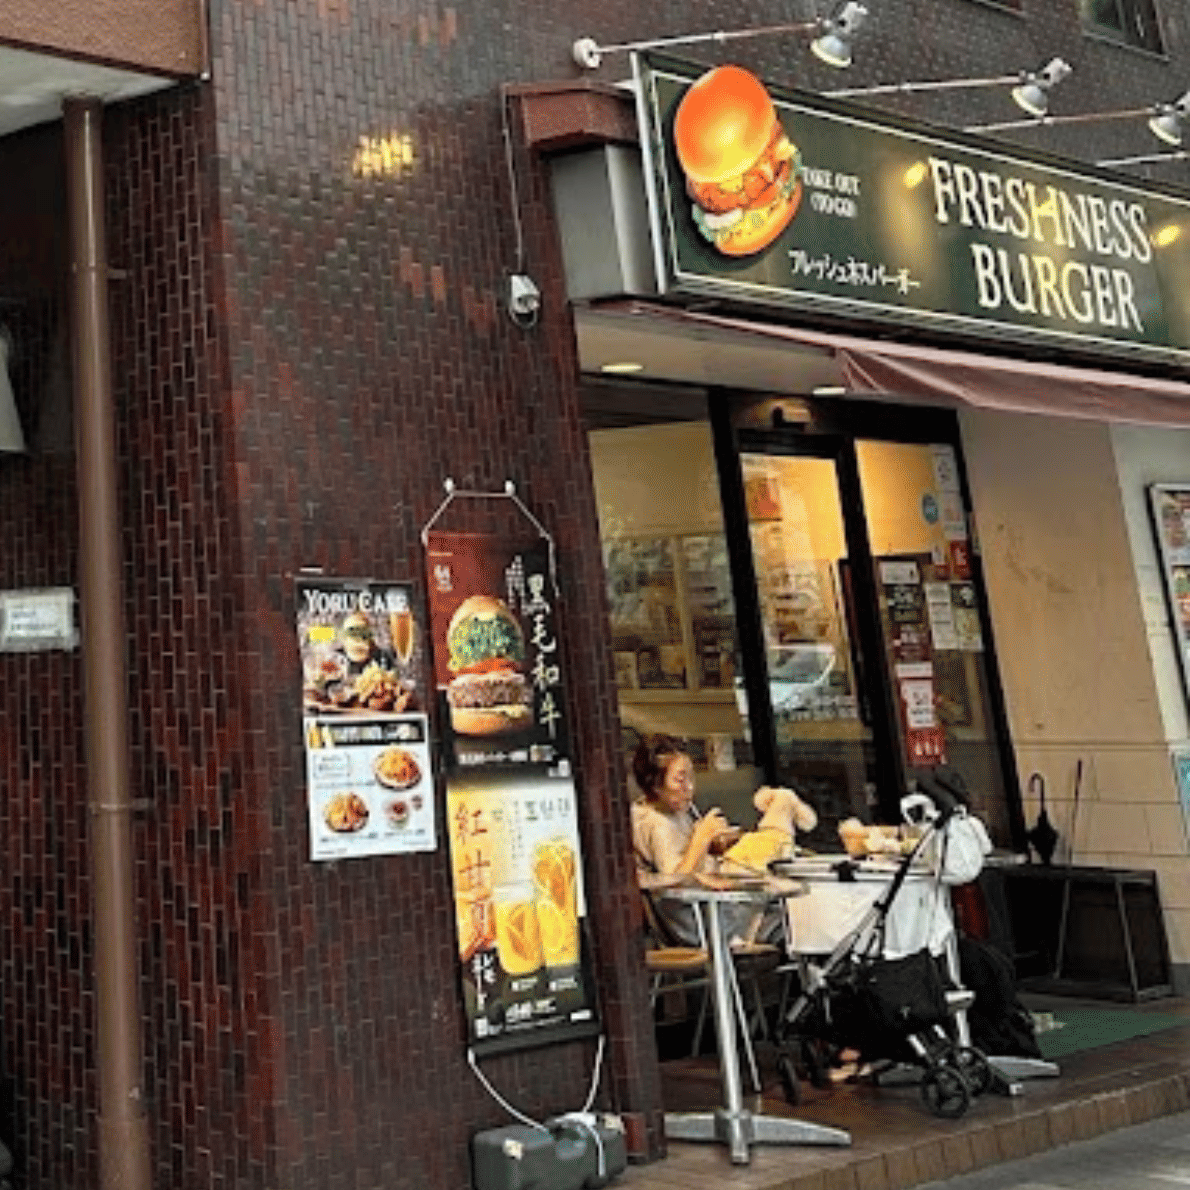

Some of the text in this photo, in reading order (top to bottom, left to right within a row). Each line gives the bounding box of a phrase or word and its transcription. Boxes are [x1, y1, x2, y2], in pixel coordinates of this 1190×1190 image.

[928, 156, 1151, 263] FRESHNESS
[971, 243, 1144, 332] BURGER
[526, 573, 562, 740] 黒毛和牛
